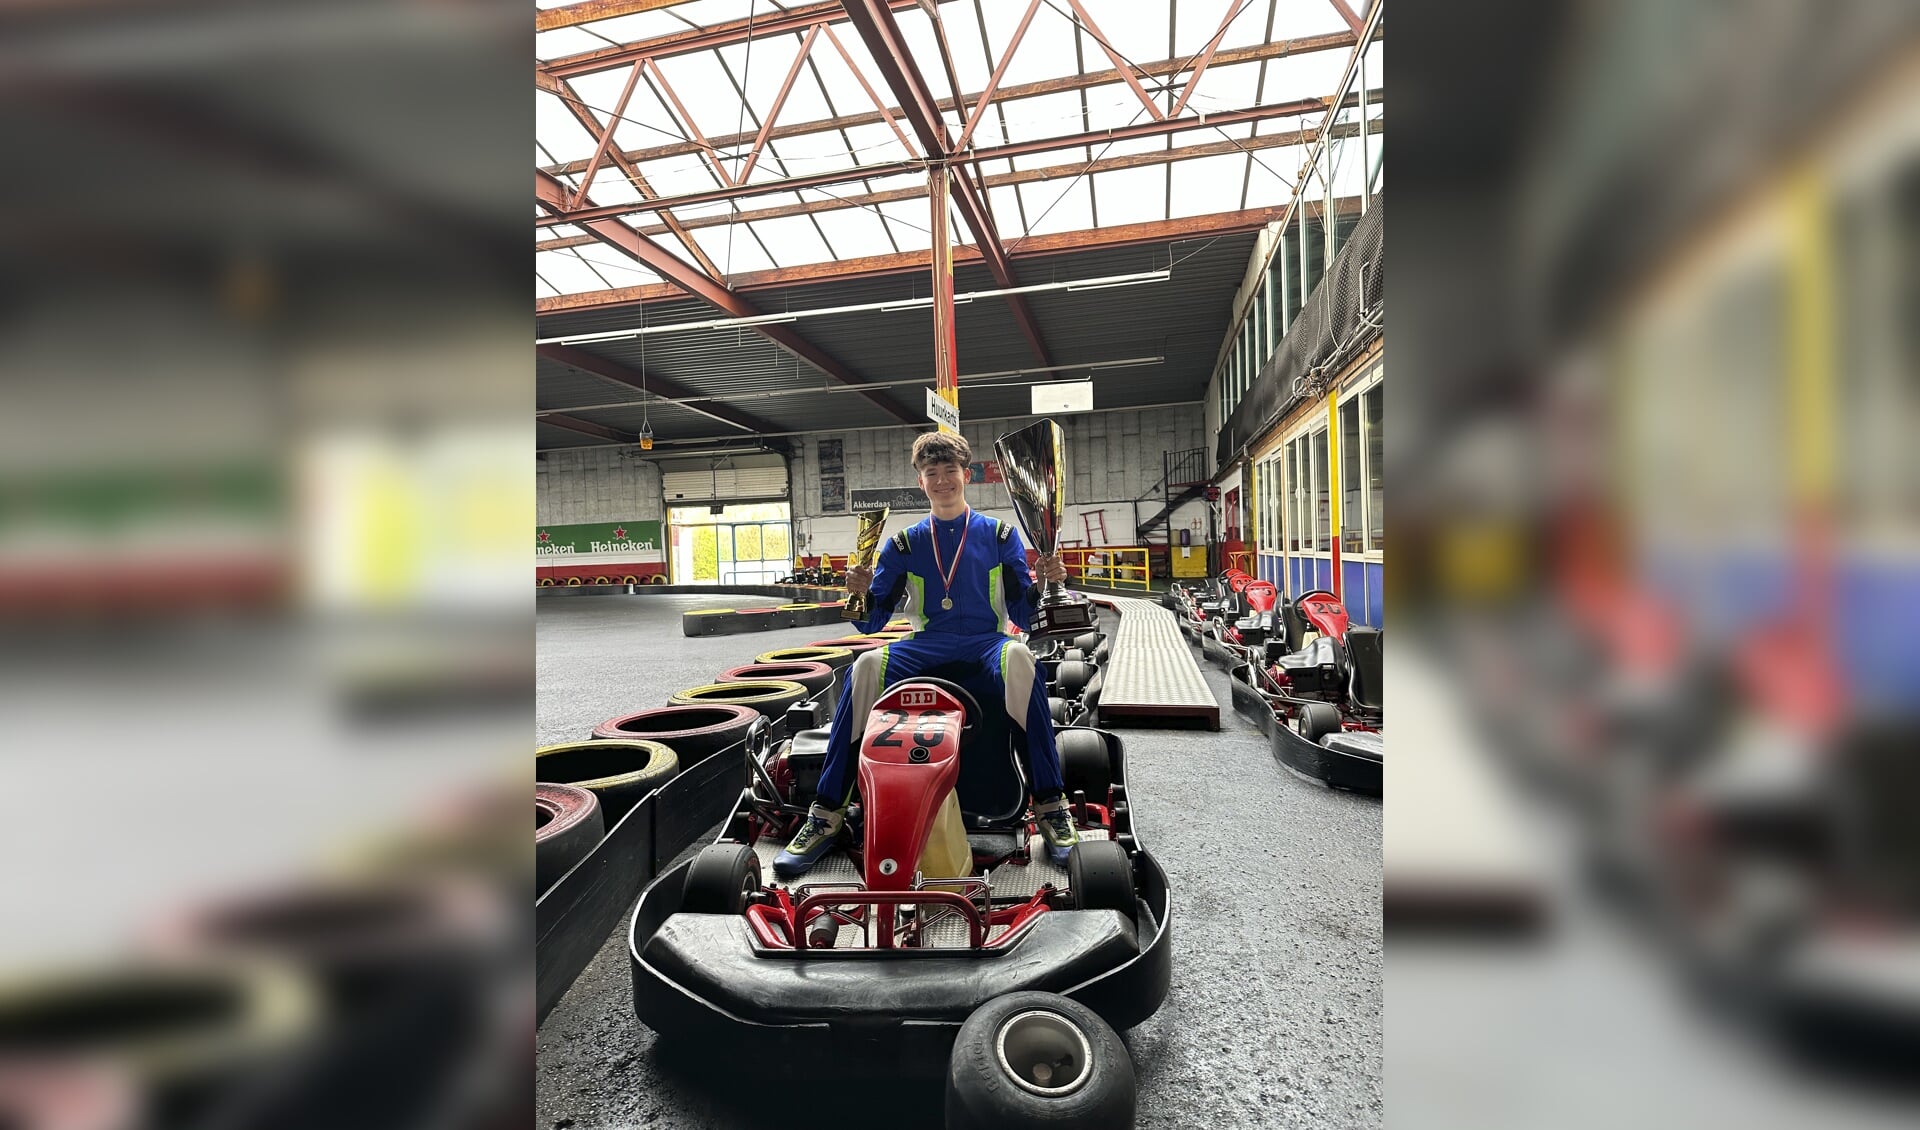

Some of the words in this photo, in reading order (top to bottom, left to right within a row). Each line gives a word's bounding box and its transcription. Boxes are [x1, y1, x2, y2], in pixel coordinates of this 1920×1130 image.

[931, 396, 957, 427] Huurkarts
[853, 499, 891, 509] Akkerdaas
[590, 540, 653, 553] Heineken
